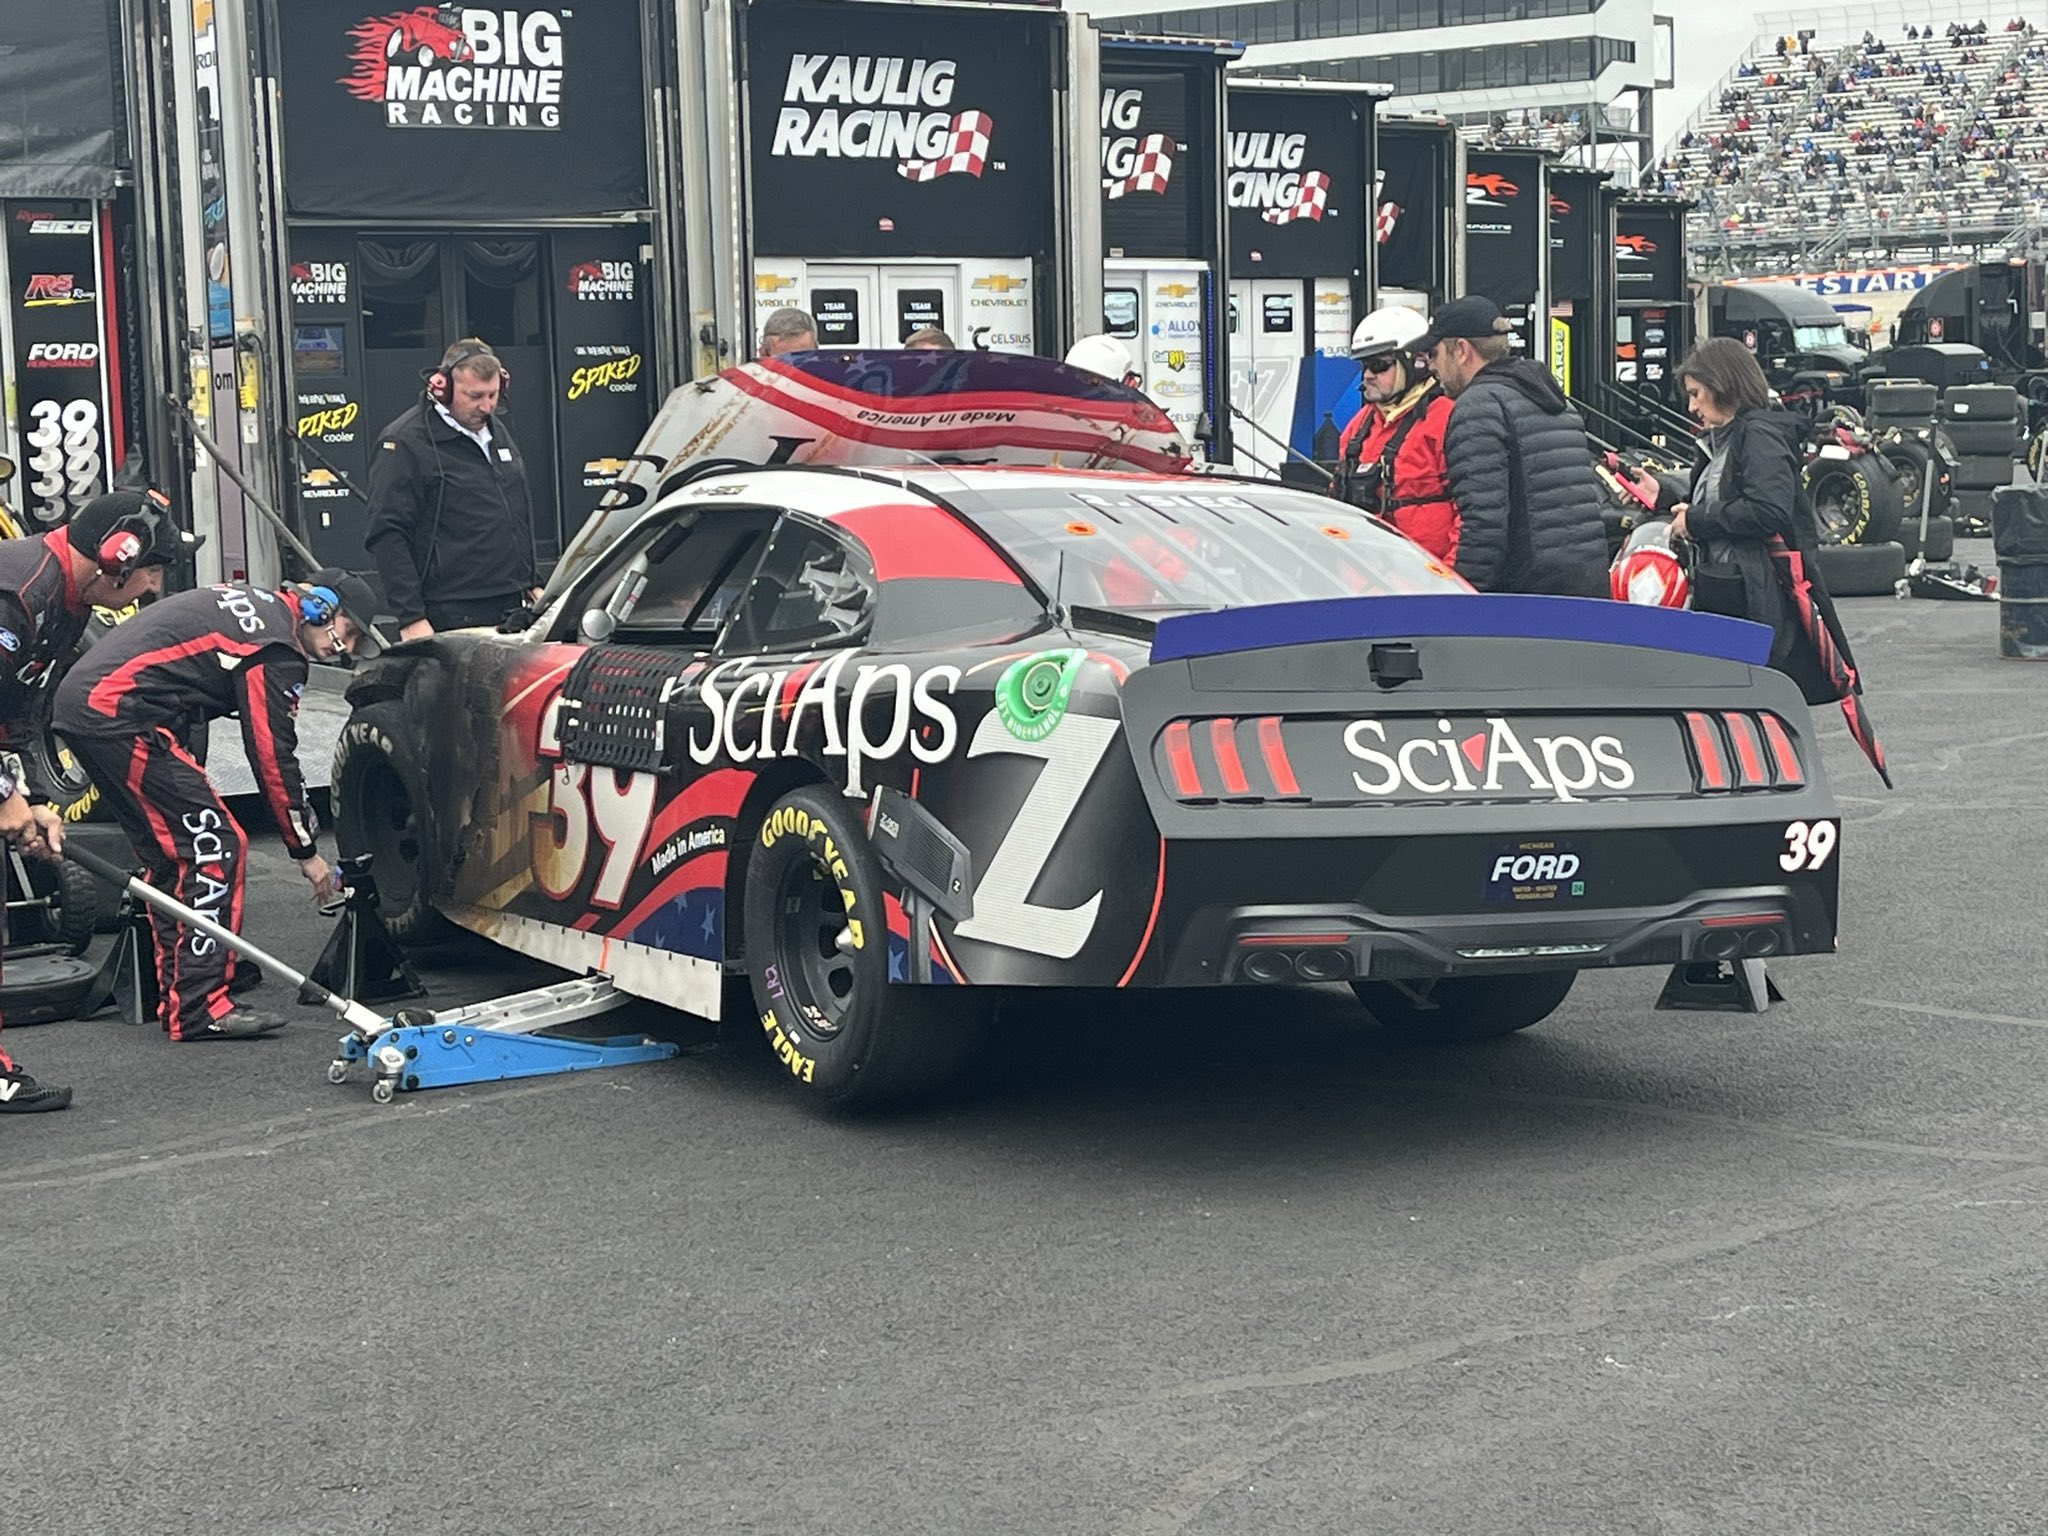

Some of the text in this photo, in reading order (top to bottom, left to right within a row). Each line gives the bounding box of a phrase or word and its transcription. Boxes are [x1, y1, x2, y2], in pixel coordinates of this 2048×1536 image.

[462, 8, 563, 67] BIG
[386, 66, 563, 103] MACHINE
[784, 54, 956, 106] KAULIG
[388, 102, 560, 127] RACING
[771, 107, 951, 160] RACING
[29, 220, 93, 234] SIEG
[310, 263, 347, 282] BIG
[601, 262, 635, 280] BIG
[578, 280, 634, 292] MACHINE
[578, 291, 634, 301] RACING
[971, 299, 1028, 307] CHEVROLET
[824, 303, 846, 311] TEAM
[911, 303, 932, 311] TEAM
[816, 313, 854, 321] MEMBERS
[904, 313, 939, 321] MEMBERS
[825, 322, 846, 332] ONLY
[991, 333, 1031, 345] CELSIUS
[28, 342, 99, 361] FORD
[567, 353, 642, 400] SPIKED
[609, 381, 639, 393] cooler
[27, 398, 98, 448] 39
[856, 410, 1016, 428] Made in America
[322, 431, 354, 443] cooler
[688, 646, 959, 798] SciAps
[1343, 717, 1636, 804] SciAps
[651, 823, 726, 876] Made in America
[1778, 820, 1838, 873] 39
[1490, 854, 1580, 882] FORD
[760, 1008, 816, 1084] EAGLE
